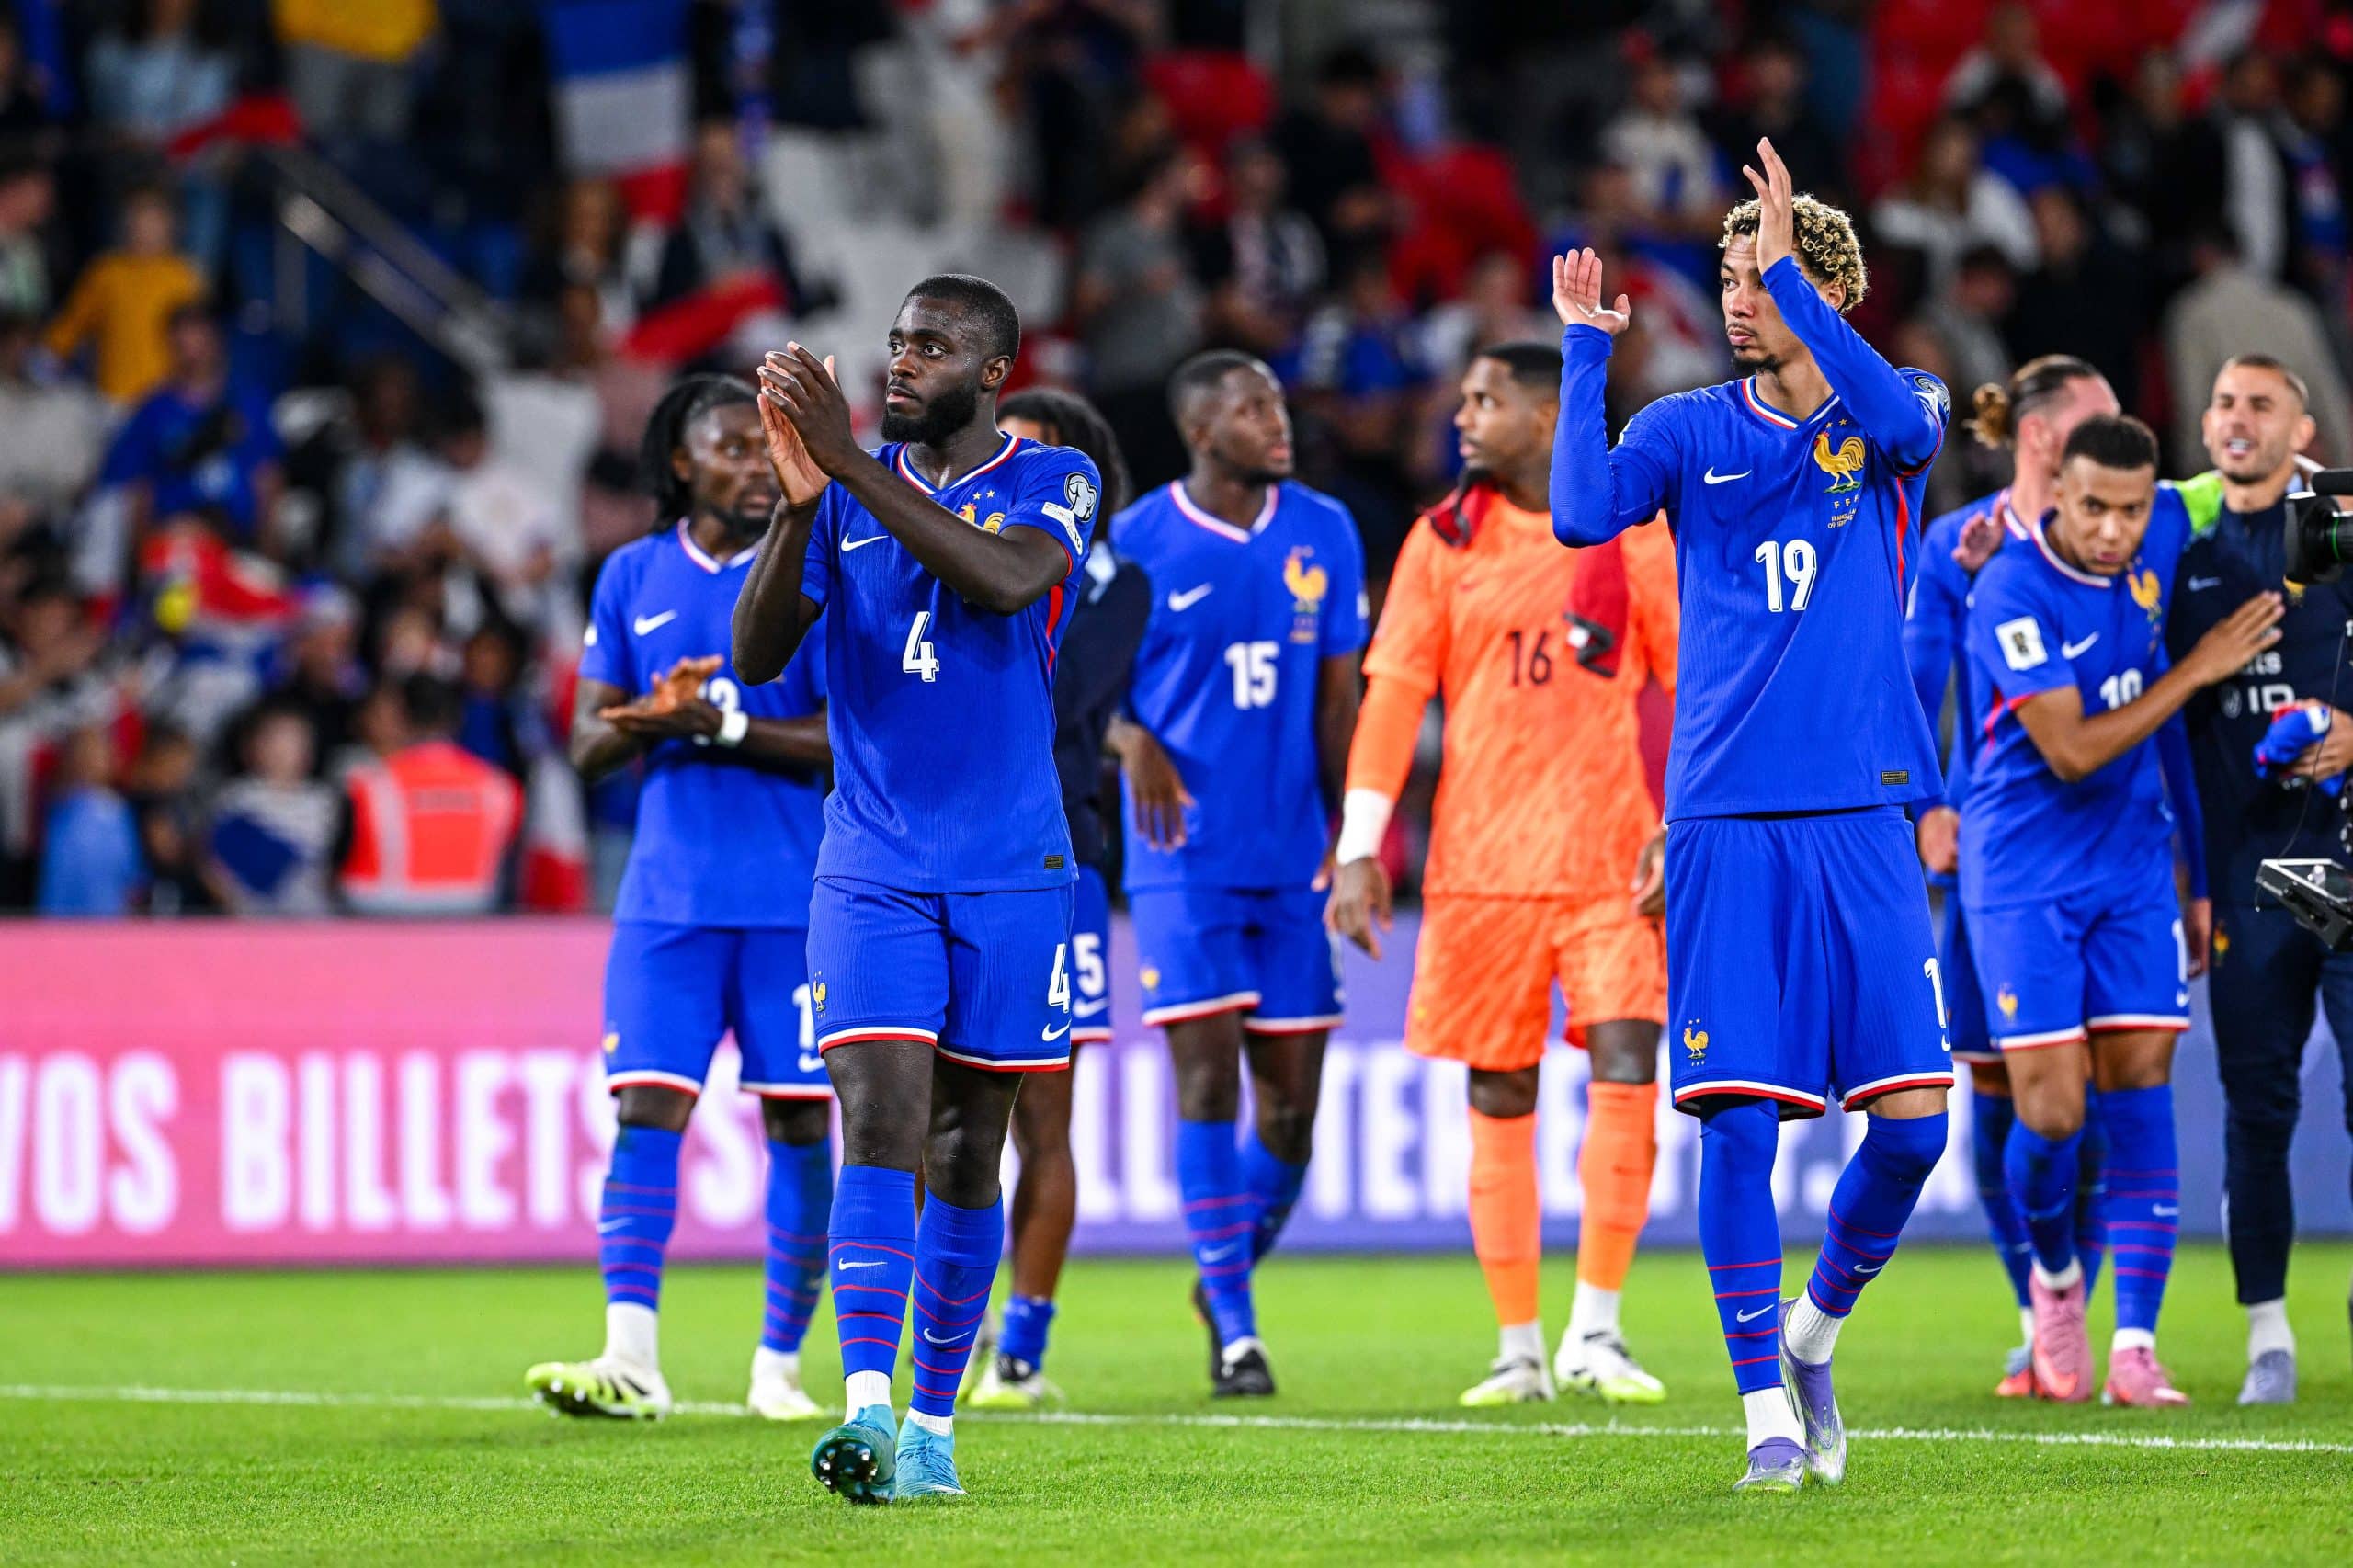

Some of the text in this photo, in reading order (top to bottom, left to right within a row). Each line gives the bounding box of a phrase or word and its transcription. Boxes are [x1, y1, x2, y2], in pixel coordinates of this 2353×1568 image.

[1755, 539, 1817, 612] 19
[902, 611, 939, 682] 4
[1224, 641, 1279, 710] 15
[1506, 631, 1552, 686] 16
[1048, 942, 1071, 1014] 4
